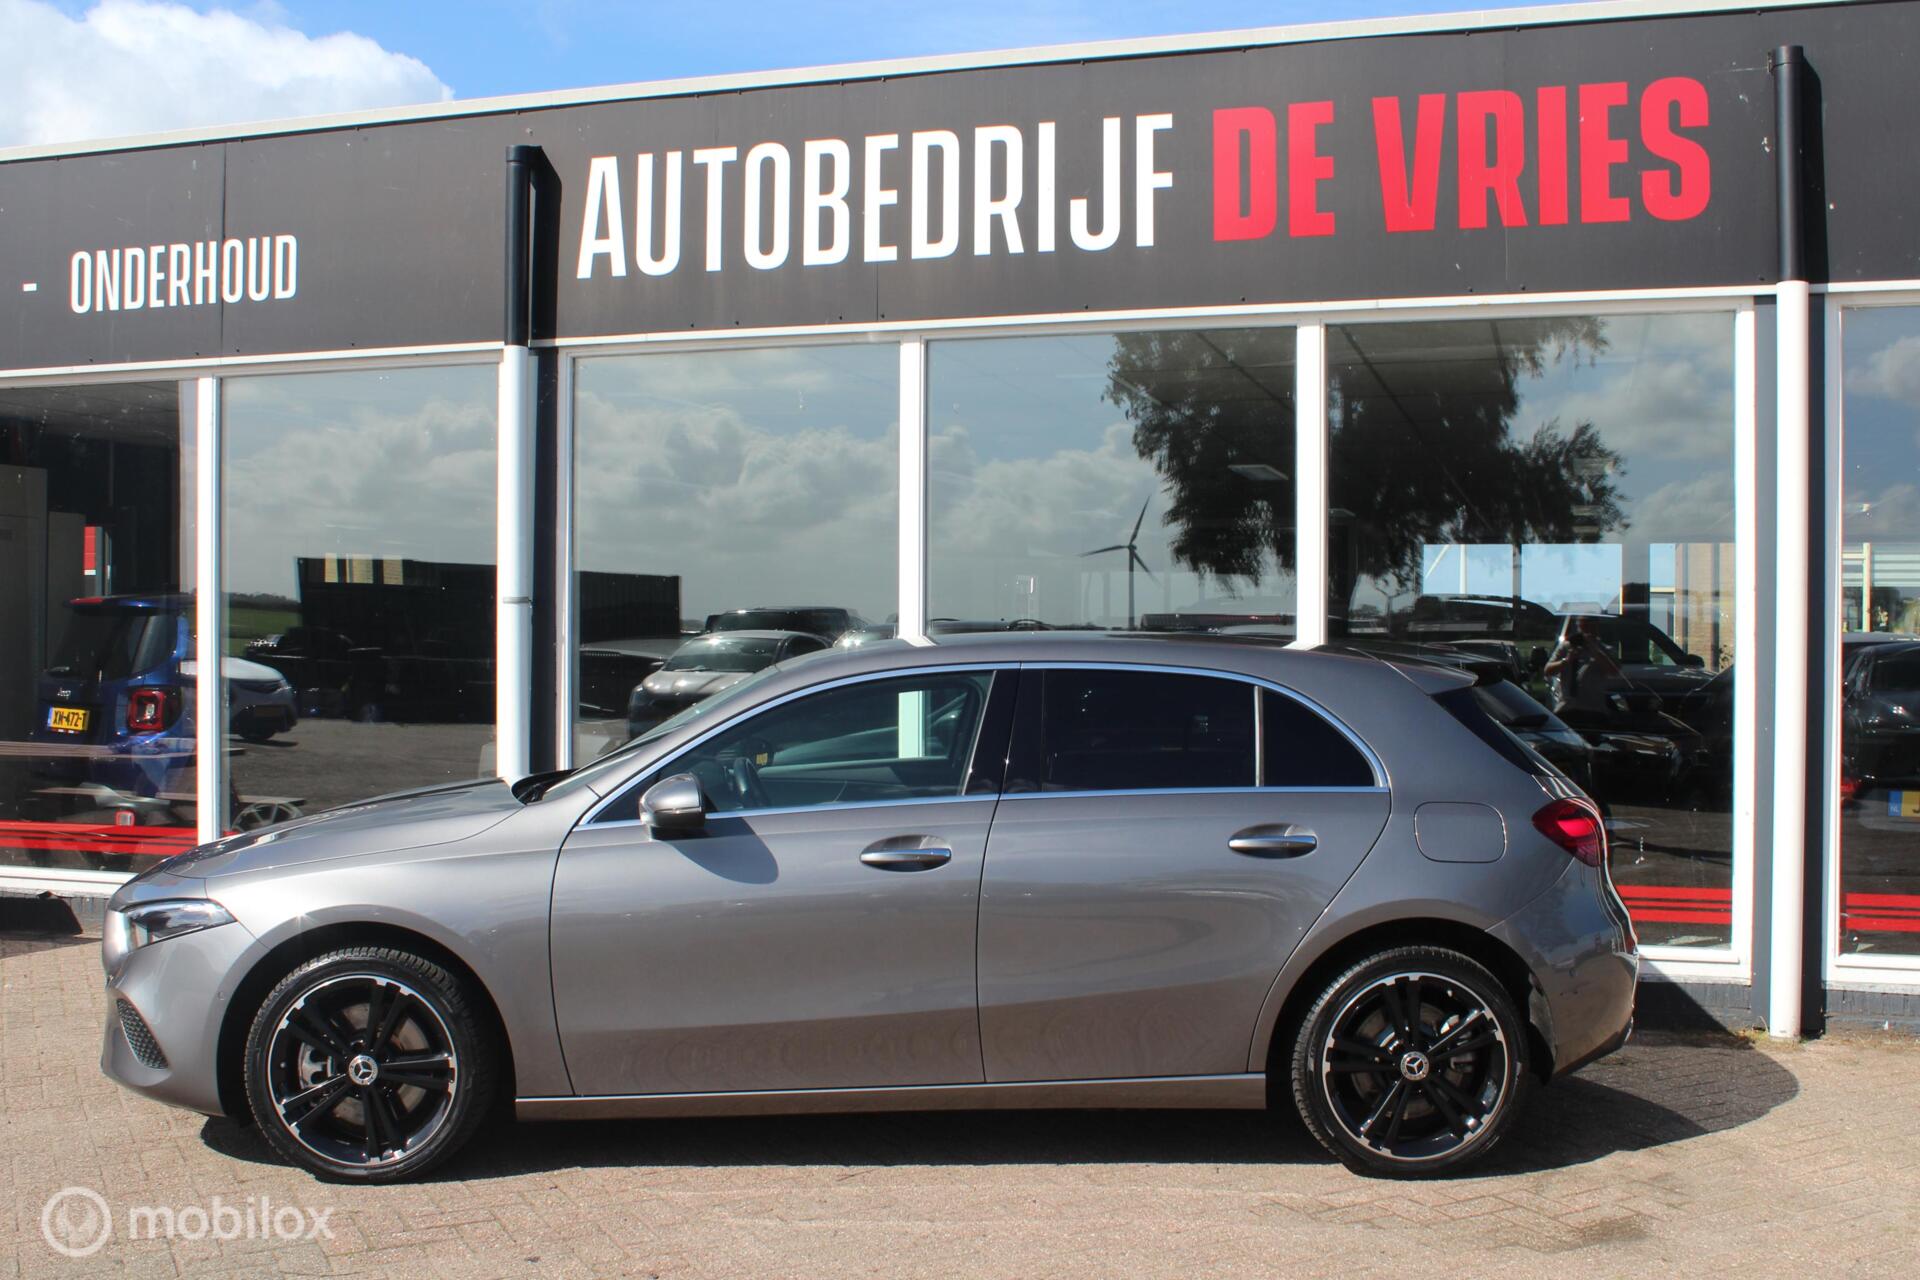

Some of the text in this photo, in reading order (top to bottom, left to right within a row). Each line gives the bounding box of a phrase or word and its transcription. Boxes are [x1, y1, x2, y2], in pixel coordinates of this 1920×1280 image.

[576, 76, 1711, 279] AUTOBEDRIJF DE VRIES
[70, 234, 297, 314] ONDERHOUD
